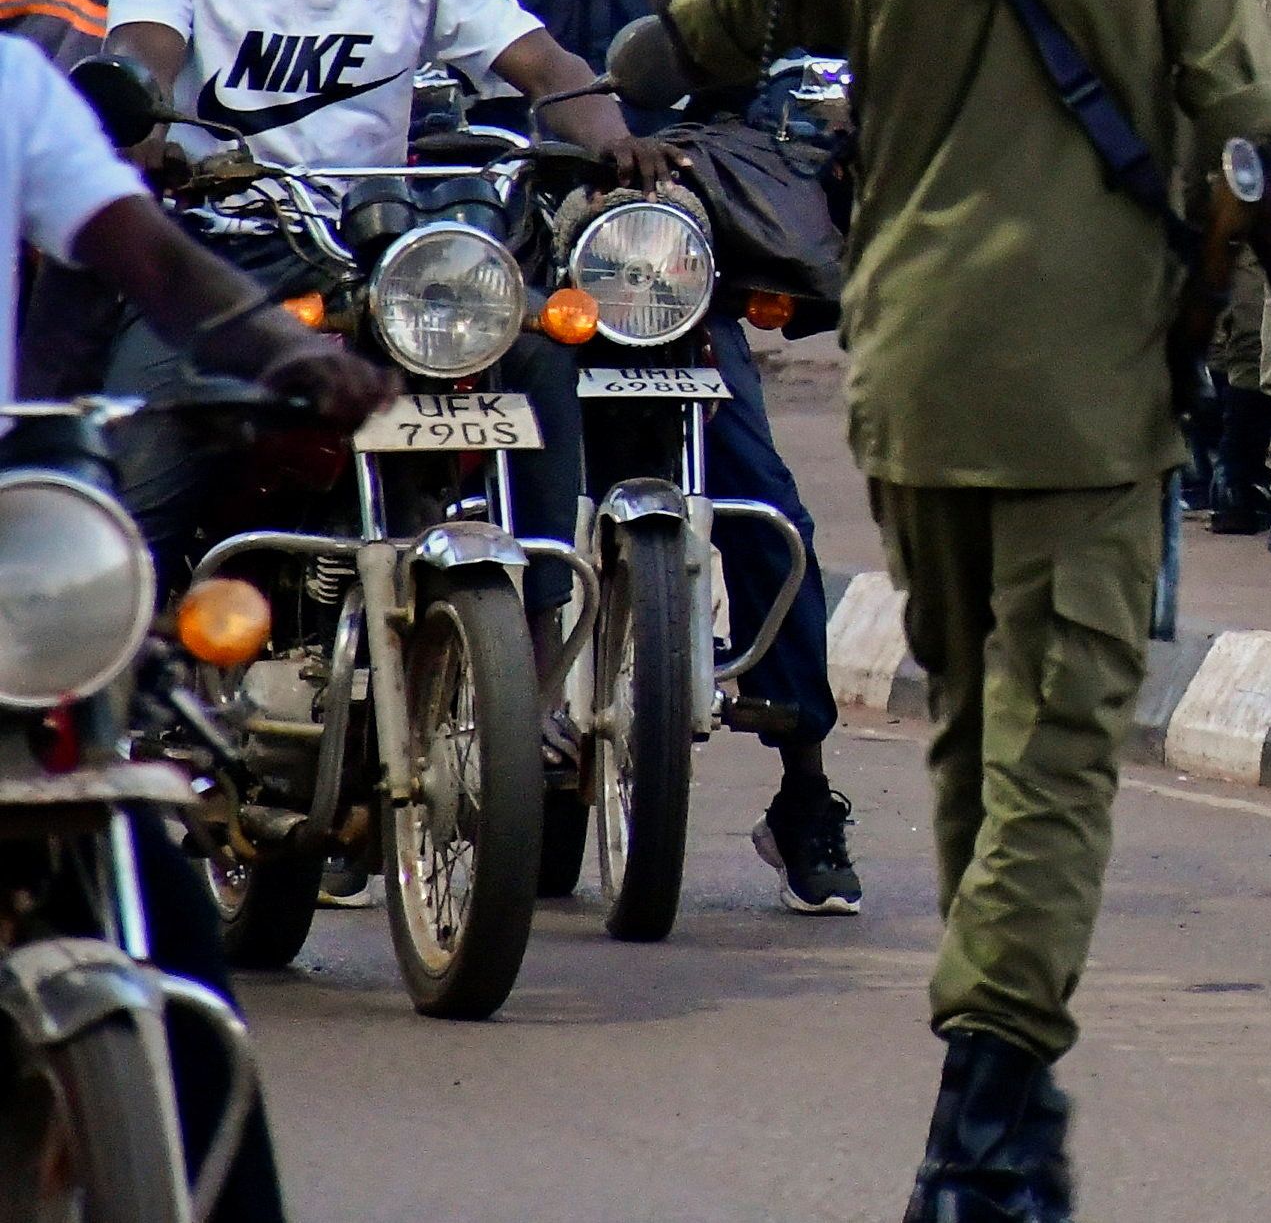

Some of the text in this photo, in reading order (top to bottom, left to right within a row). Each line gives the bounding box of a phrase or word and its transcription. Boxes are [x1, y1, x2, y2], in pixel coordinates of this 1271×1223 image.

[223, 30, 375, 95] NIKE
[604, 381, 722, 394] 698BY
[413, 394, 507, 419] UFK
